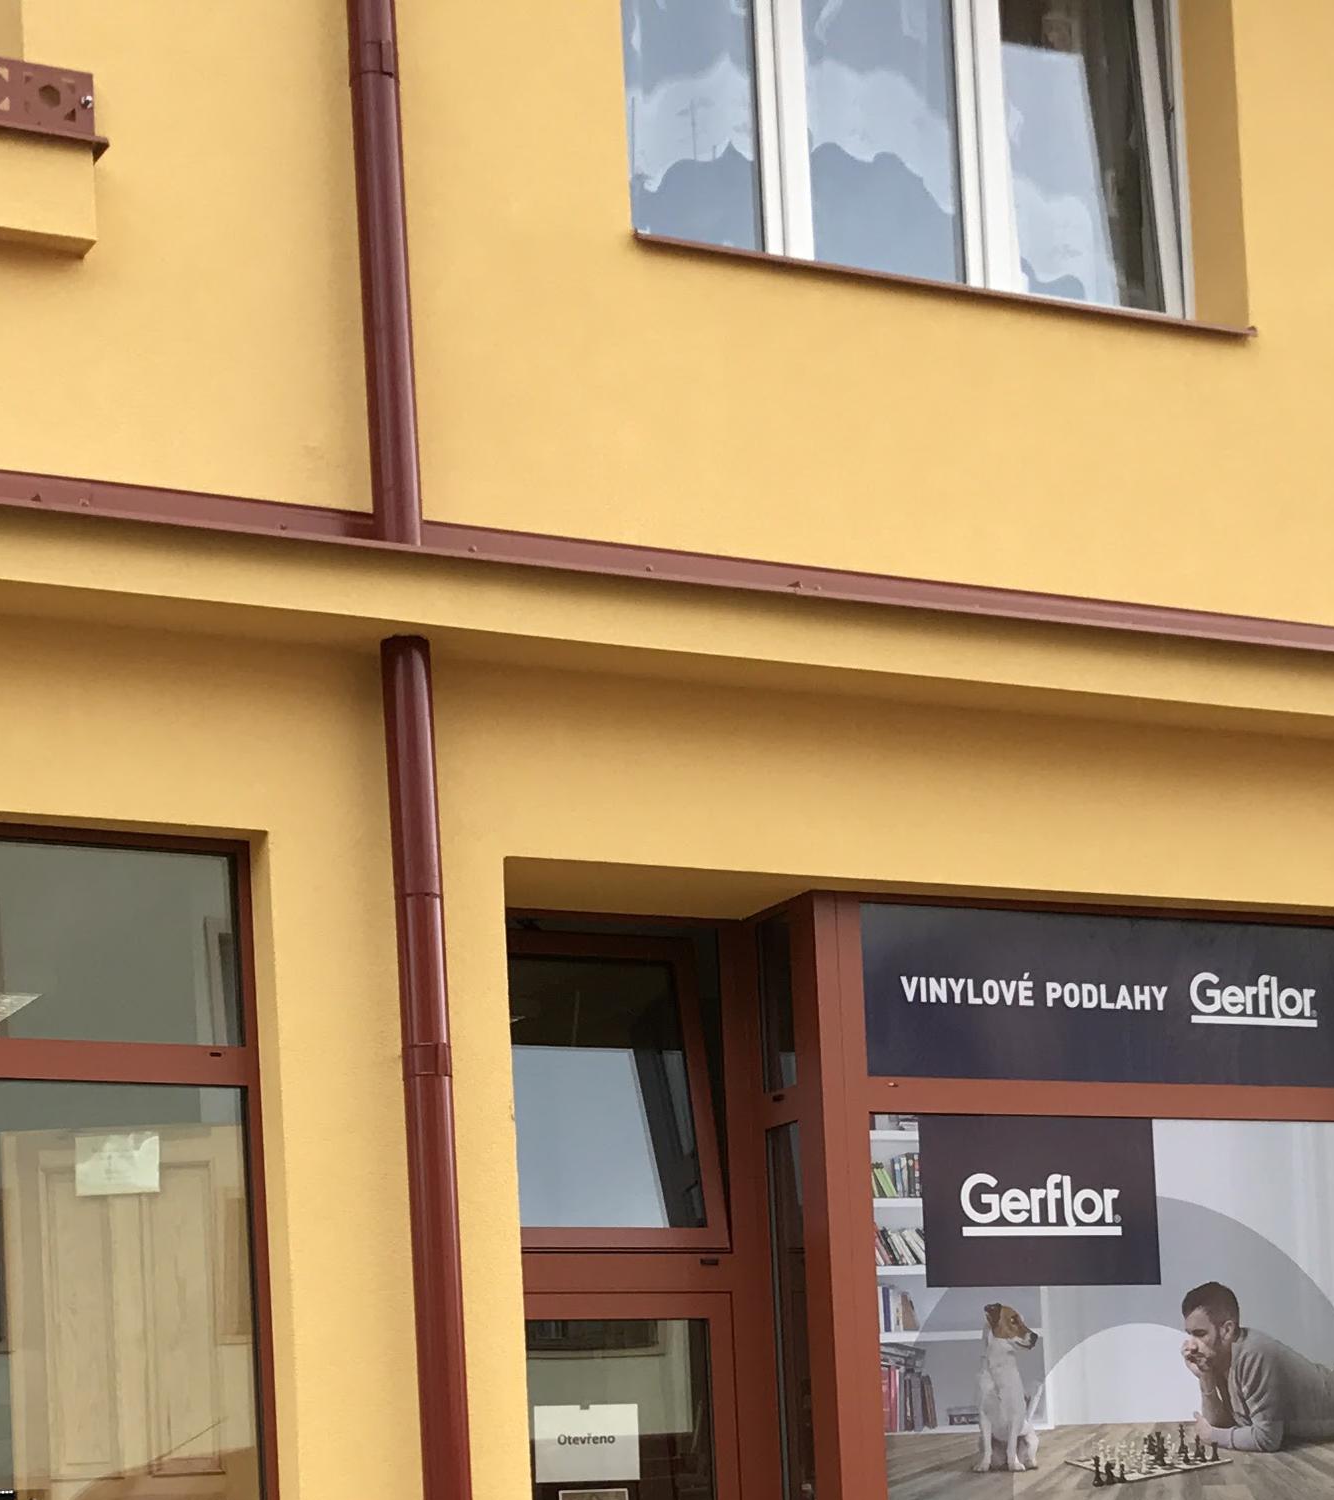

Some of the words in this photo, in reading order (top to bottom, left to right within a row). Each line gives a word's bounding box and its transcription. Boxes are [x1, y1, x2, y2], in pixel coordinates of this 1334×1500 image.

[900, 972, 1035, 1007] VINYLOVÉ
[1046, 981, 1169, 1011] PODLAHY
[1190, 971, 1317, 1019] Gerflor
[960, 1173, 1120, 1227] Gerflor
[557, 1433, 616, 1446] Otevřeno
